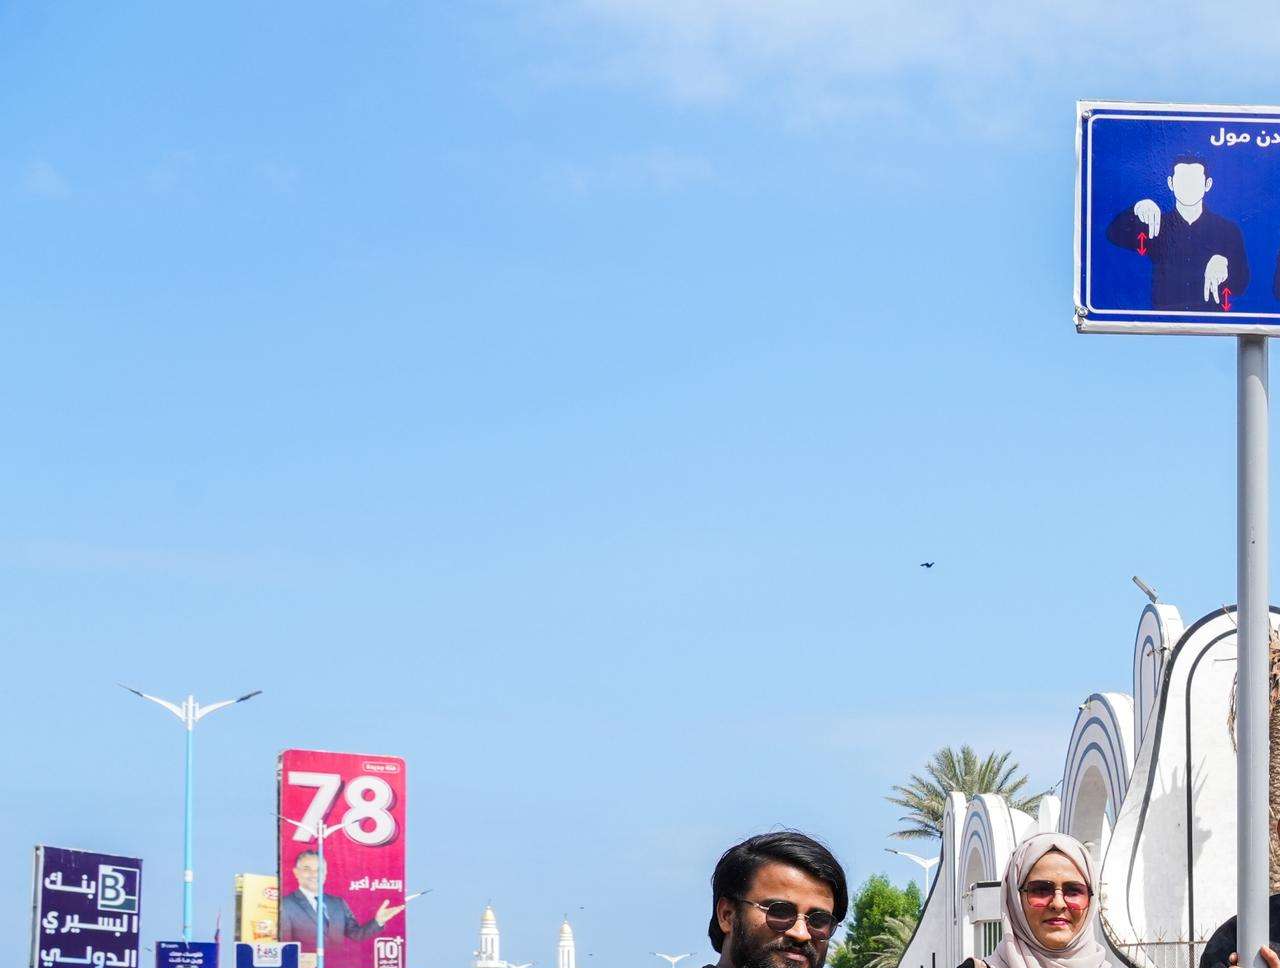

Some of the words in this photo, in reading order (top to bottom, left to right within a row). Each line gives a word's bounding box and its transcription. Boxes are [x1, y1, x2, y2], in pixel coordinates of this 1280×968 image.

[1210, 127, 1251, 146] مول
[287, 770, 397, 846] 78
[44, 871, 96, 899] بنك
[349, 876, 369, 890] أكبر
[42, 910, 138, 937] البسيري
